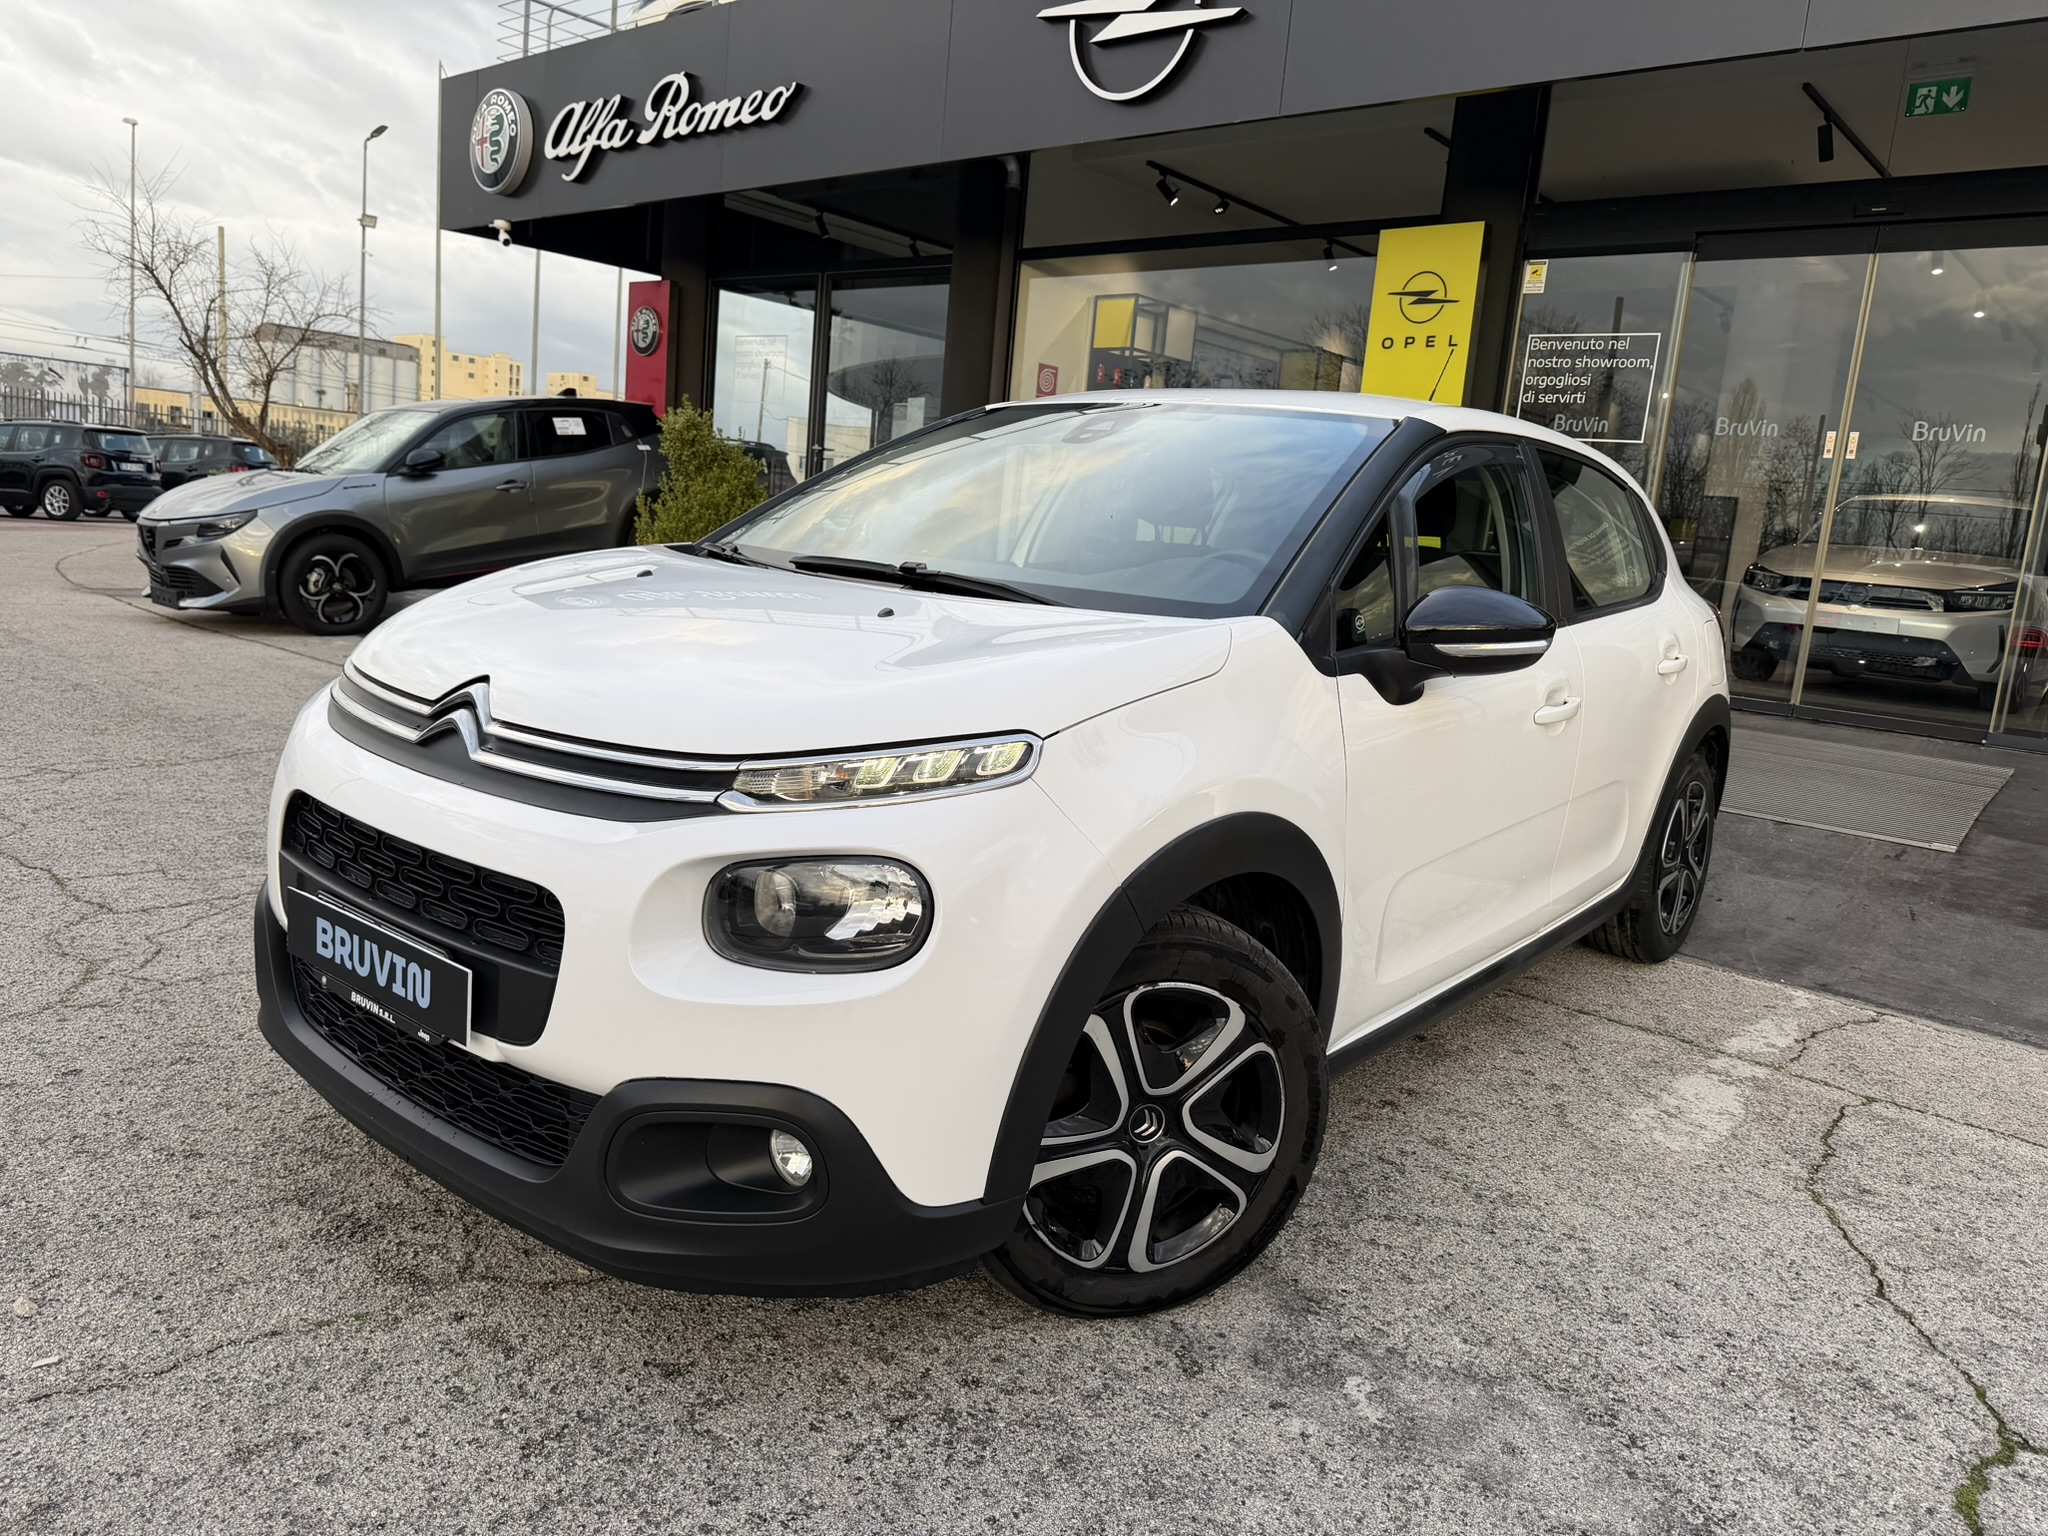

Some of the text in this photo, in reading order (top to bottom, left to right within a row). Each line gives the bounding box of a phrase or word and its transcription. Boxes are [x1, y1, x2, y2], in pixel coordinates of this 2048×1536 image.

[490, 94, 517, 137] ROMEO
[544, 71, 797, 182] Alfa Romeo
[1381, 334, 1458, 350] OPEL
[1530, 337, 1630, 350] Benvenuto nel
[1527, 355, 1653, 370] nostro showroom,
[1525, 373, 1591, 389] orgogliosi
[1522, 391, 1586, 404] di servirti
[1553, 413, 1609, 433] BruVin
[1714, 416, 1779, 437] BruVin
[1911, 420, 1987, 443] BruVin
[316, 916, 431, 1009] BRUVIN
[350, 991, 379, 1015] BRUVIN
